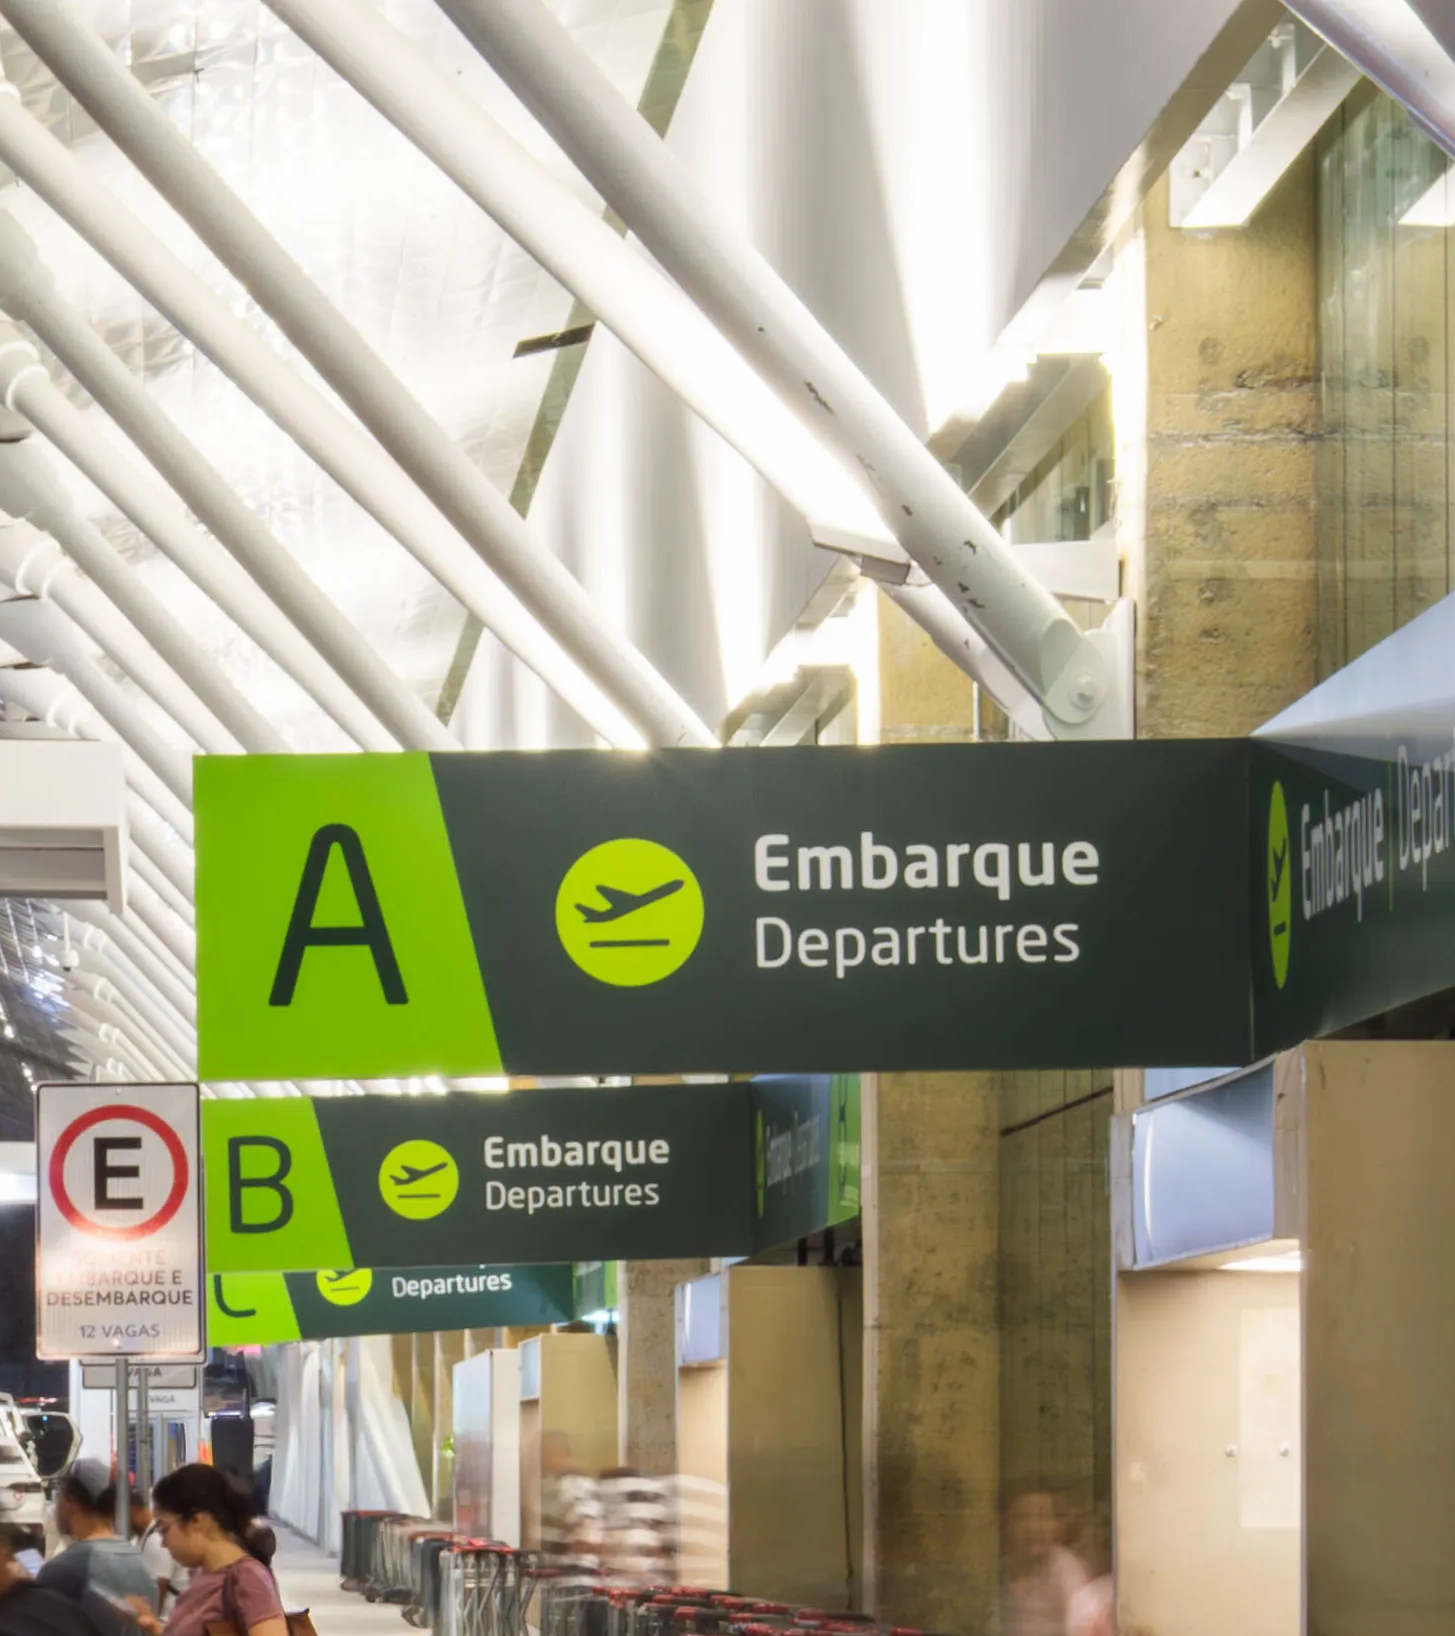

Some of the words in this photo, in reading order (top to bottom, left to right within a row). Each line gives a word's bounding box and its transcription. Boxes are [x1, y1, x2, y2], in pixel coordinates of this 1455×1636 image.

[755, 831, 1101, 900] Embarque
[1301, 788, 1385, 922] Embarque
[268, 823, 409, 1007] A
[756, 916, 1081, 978] Departures
[94, 1136, 143, 1210] E
[228, 1135, 293, 1234] B
[484, 1137, 669, 1171] Embarque
[486, 1180, 659, 1214] Departures
[46, 1290, 193, 1306] DESEMBARQUE
[391, 1273, 513, 1299] Departures
[79, 1325, 95, 1338] 12
[102, 1323, 160, 1338] VAGAS
